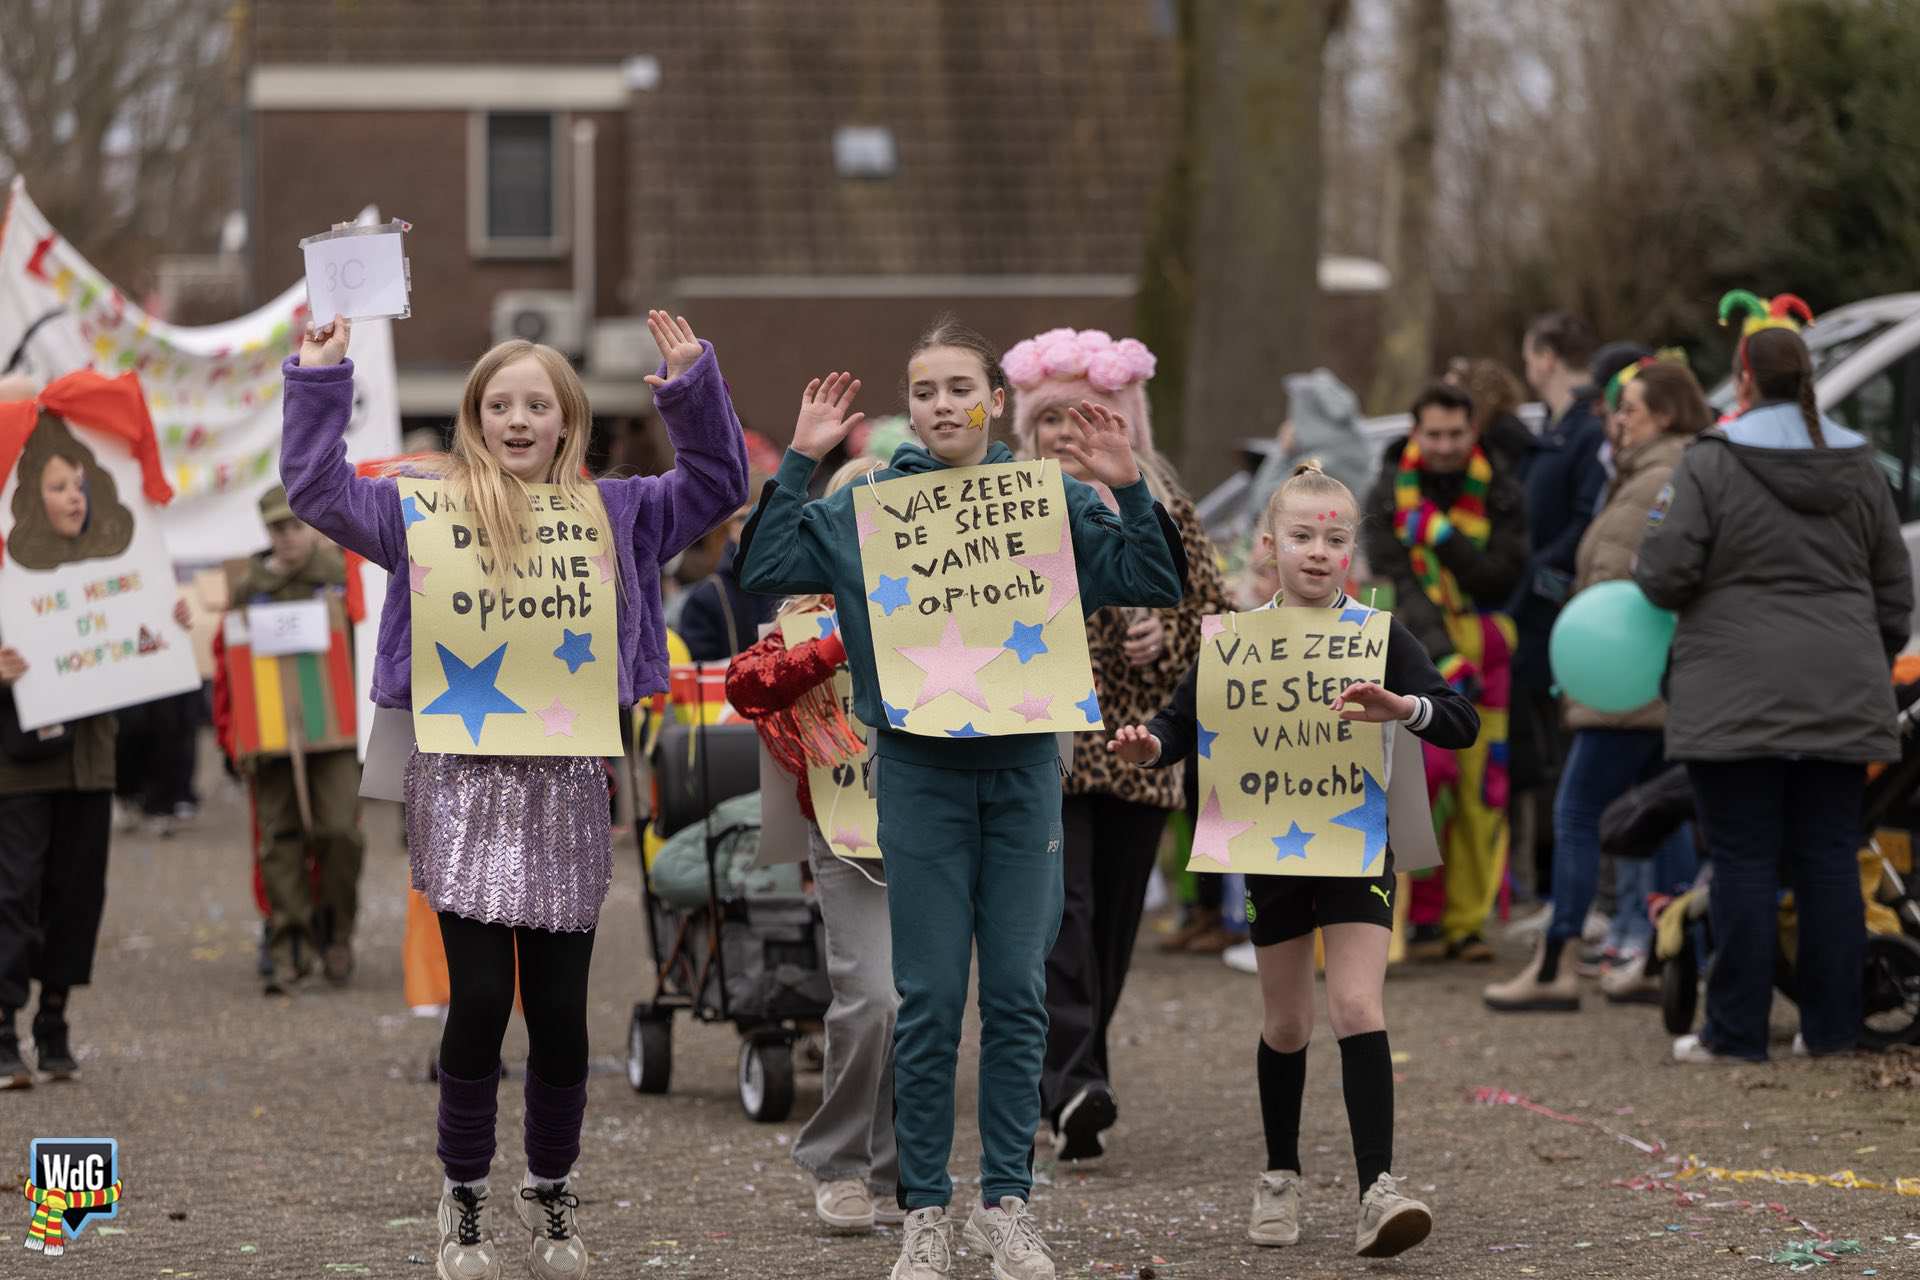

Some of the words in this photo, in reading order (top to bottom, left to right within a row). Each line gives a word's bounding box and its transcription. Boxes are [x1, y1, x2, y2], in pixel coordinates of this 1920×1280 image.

[325, 258, 367, 292] 3C
[883, 485, 952, 523] VAE
[894, 525, 928, 550] DE
[911, 531, 1026, 577] VANNE
[452, 581, 592, 632] optocht
[1215, 638, 1289, 666] VAE
[1303, 633, 1383, 659] ZEEN
[1227, 678, 1267, 710] DE
[1253, 719, 1353, 751] VANNE
[1240, 762, 1365, 805] optocht
